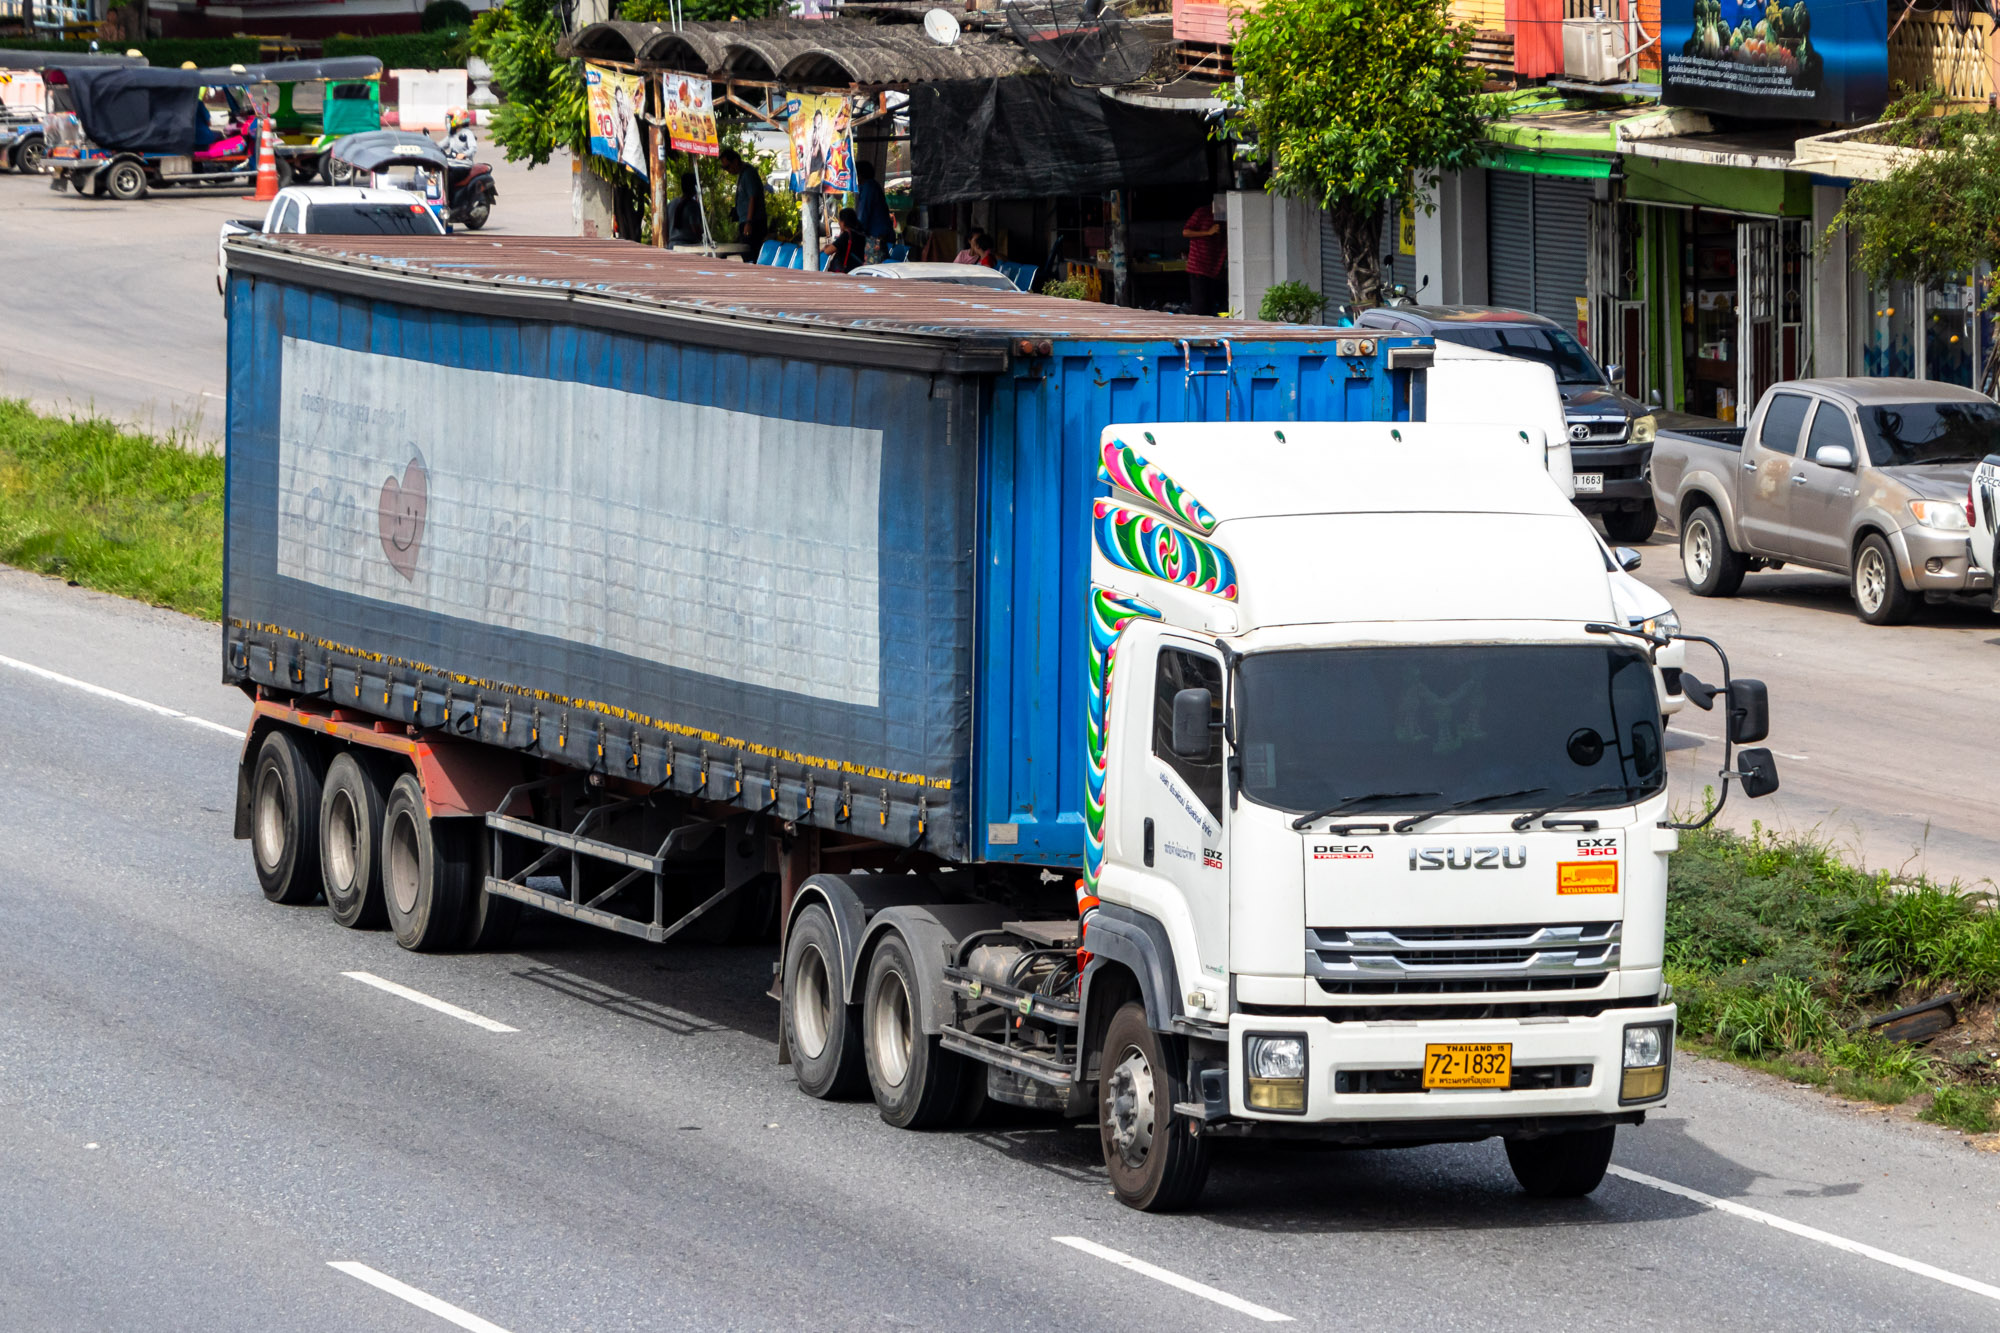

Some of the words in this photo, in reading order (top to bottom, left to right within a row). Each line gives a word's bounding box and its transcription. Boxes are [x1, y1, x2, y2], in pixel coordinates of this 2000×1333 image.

[1582, 475, 1601, 485] 1663
[1577, 838, 1617, 848] GXZ
[1203, 847, 1223, 861] GXZ
[1314, 845, 1373, 853] DECA
[1577, 847, 1618, 857] 360
[1203, 856, 1223, 870] 360
[1409, 846, 1527, 871] ISUZU
[1430, 1053, 1506, 1075] 72-1832
[1439, 1076, 1496, 1087] พระนครศรีอยุธยา
